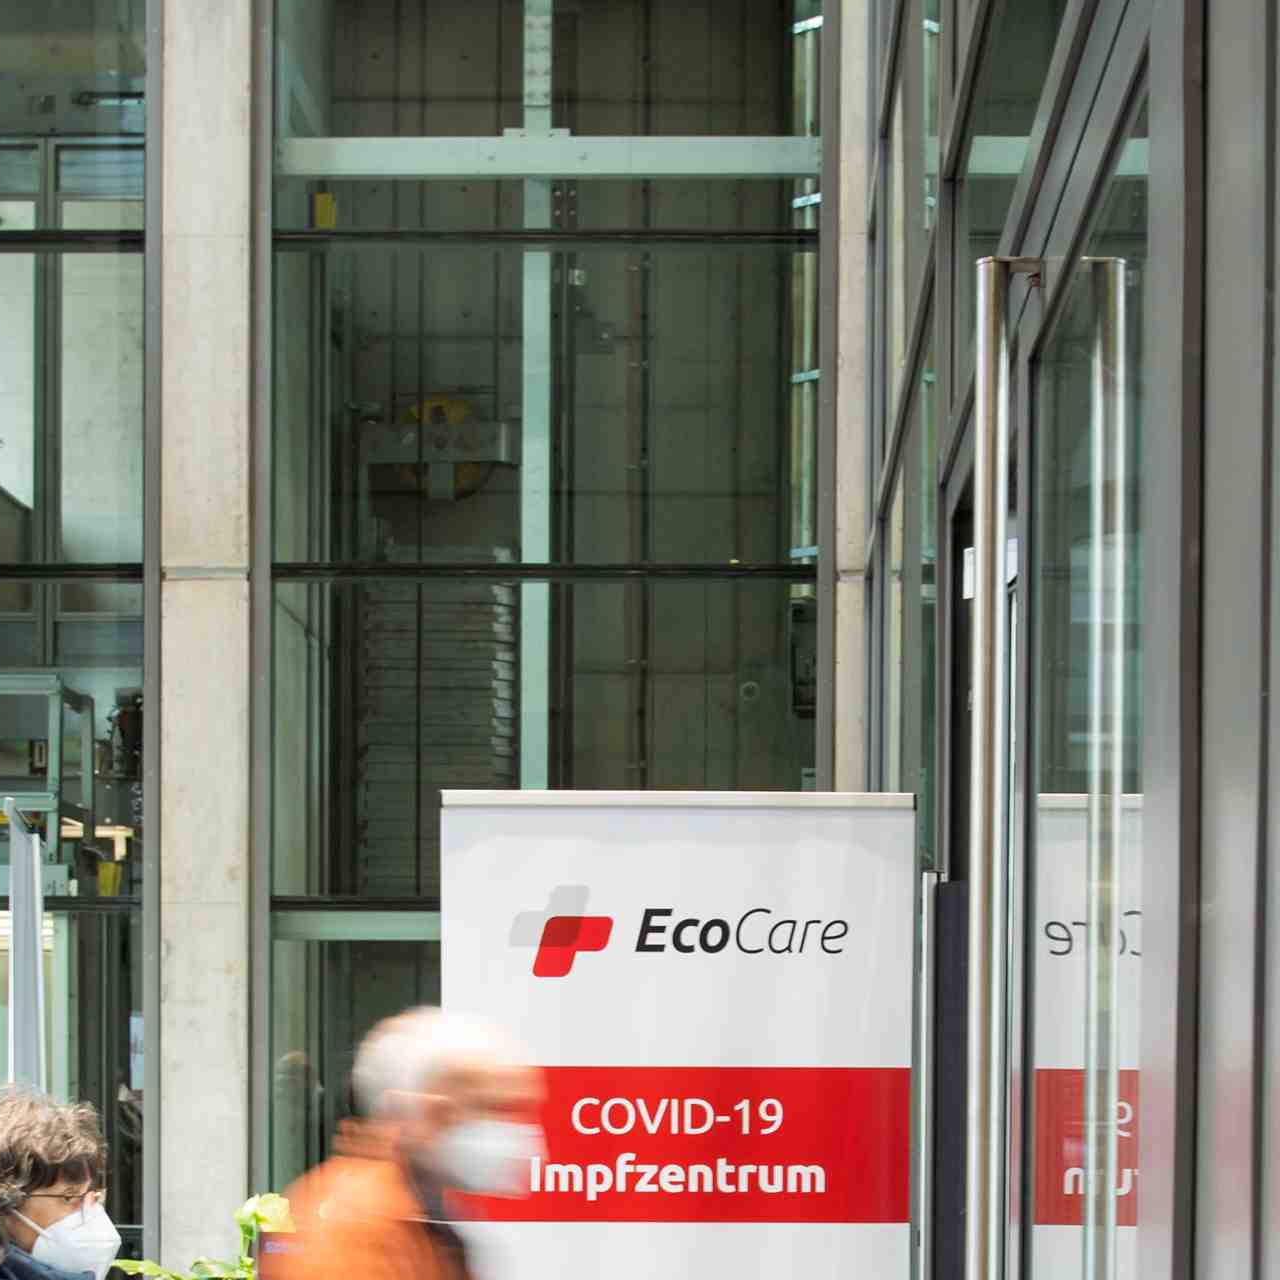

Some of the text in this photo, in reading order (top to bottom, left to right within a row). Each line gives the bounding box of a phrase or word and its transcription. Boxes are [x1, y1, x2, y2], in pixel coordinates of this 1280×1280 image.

[634, 907, 849, 955] EcoCare
[570, 1097, 785, 1136] COVID-19
[529, 1152, 826, 1201] Impfzentrum
